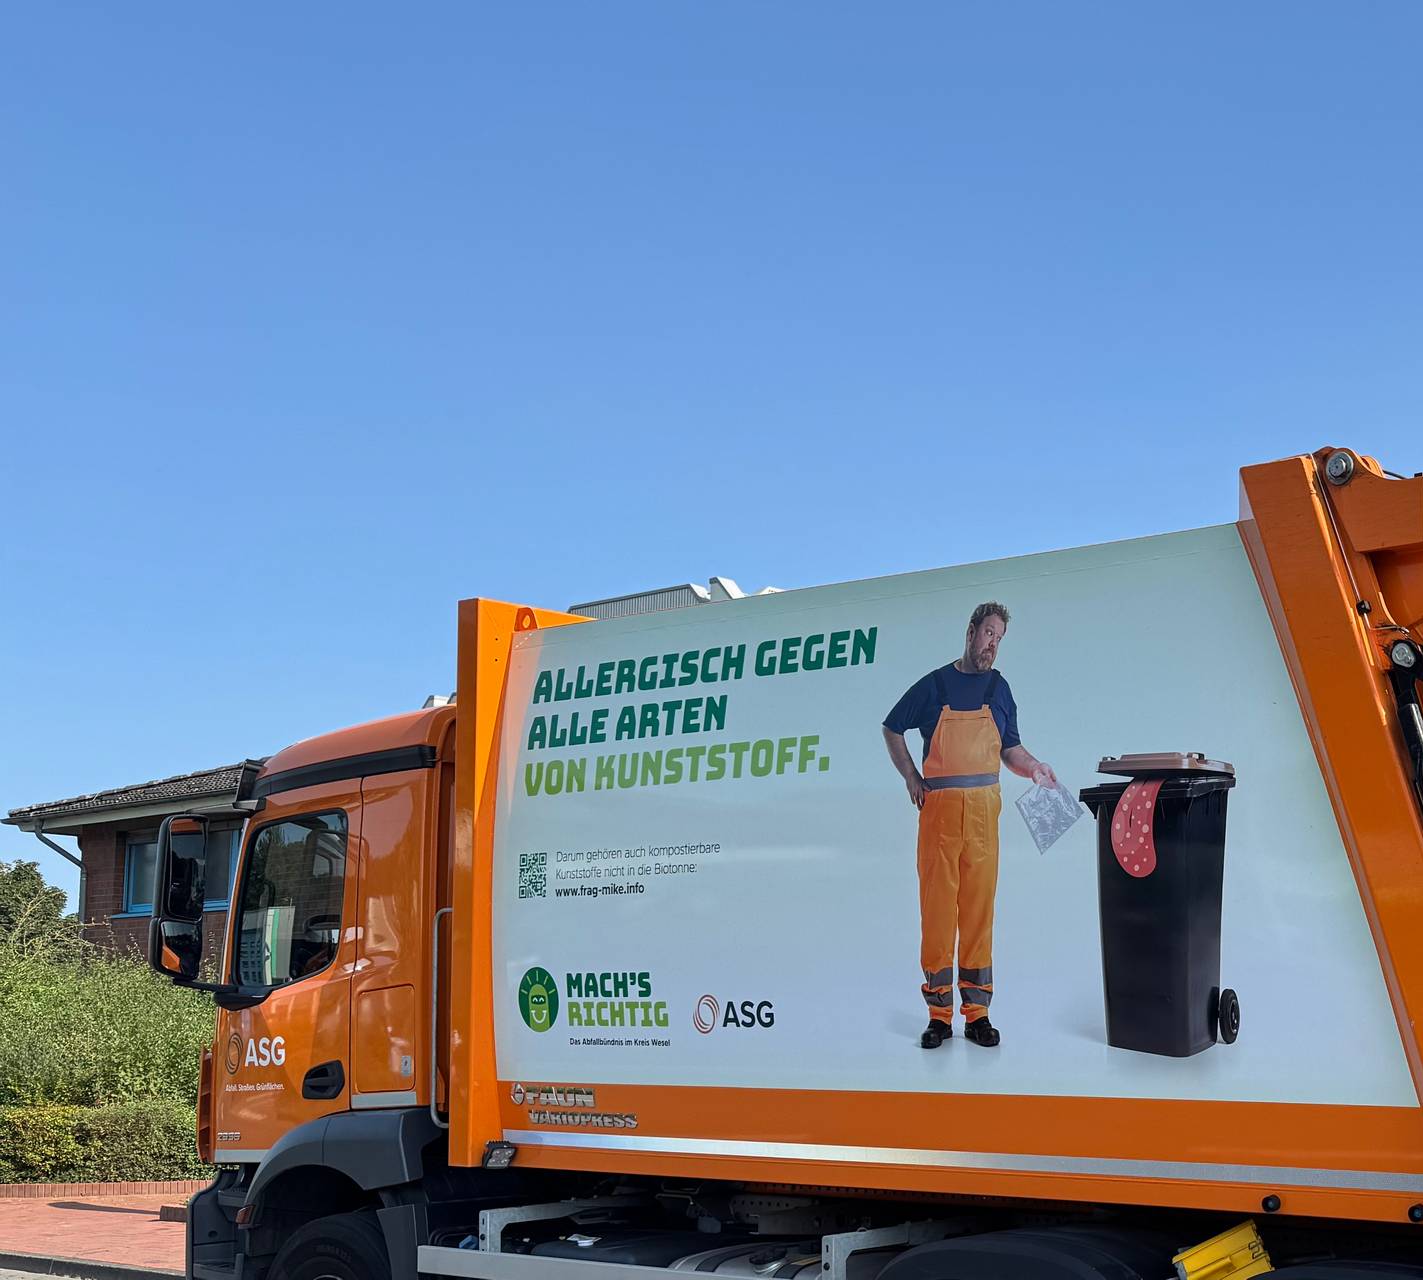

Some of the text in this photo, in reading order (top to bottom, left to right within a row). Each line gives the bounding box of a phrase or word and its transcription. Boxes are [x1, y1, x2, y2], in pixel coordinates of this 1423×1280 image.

[532, 626, 878, 704] ALLERGISCH GEGEN
[527, 694, 728, 750] ALLE ARTEN
[525, 735, 830, 797] VON KUNSTSTOFF.
[556, 842, 720, 863] Darum gehören auch kompostierbare
[556, 862, 697, 880] Kunststoffe nicht in die Biotonne:
[555, 882, 645, 897] www.frag-mike.info
[566, 972, 651, 998] MACH'S
[567, 1001, 669, 1027] RICHTIG
[722, 1001, 775, 1028] ASG
[245, 1036, 286, 1067] ASG
[582, 1037, 623, 1046] Abfallbündnis
[625, 1038, 632, 1046] im
[634, 1038, 650, 1046] Kreis
[651, 1038, 671, 1047] Wesel
[526, 1087, 595, 1107] FAUN
[528, 1109, 638, 1129] VARIOPRESS
